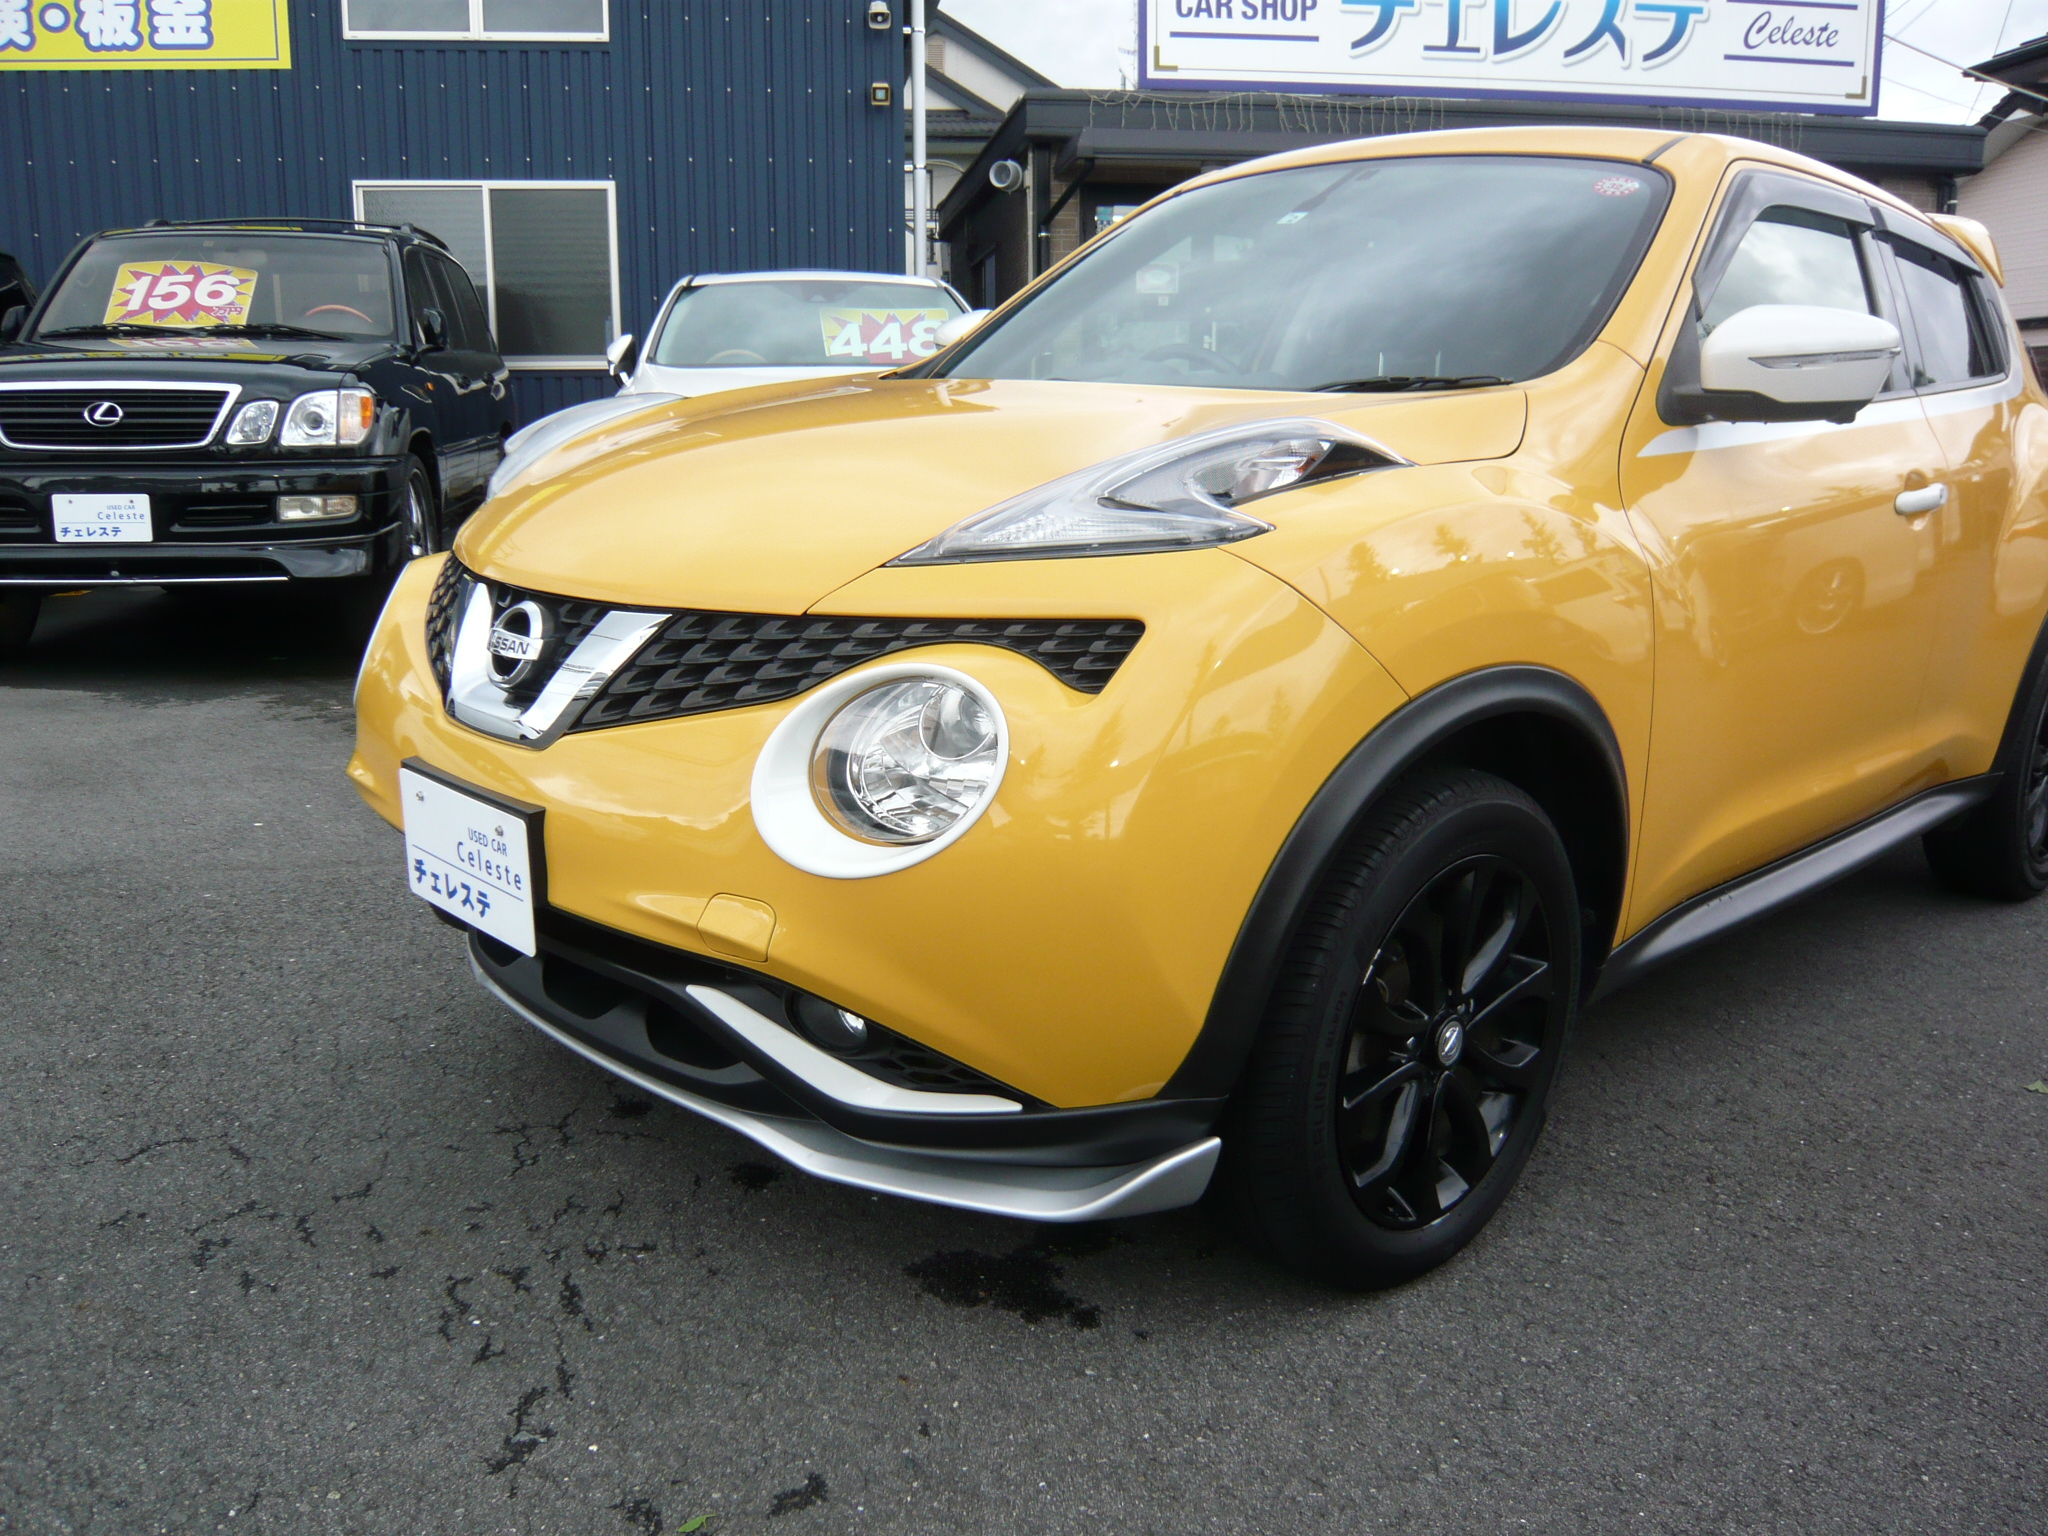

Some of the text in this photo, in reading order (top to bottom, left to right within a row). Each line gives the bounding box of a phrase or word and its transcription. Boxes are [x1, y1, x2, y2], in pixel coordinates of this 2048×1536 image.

[1174, 0, 1318, 22] CAR SHOP
[1742, 10, 1840, 50] Celeste
[125, 274, 242, 311] 156
[829, 320, 942, 360] 448
[60, 526, 122, 537] チェレステ
[97, 511, 145, 520] Celeste
[467, 827, 508, 857] USED CAR
[457, 841, 522, 891] Celeste
[414, 858, 491, 918] チェレステ
